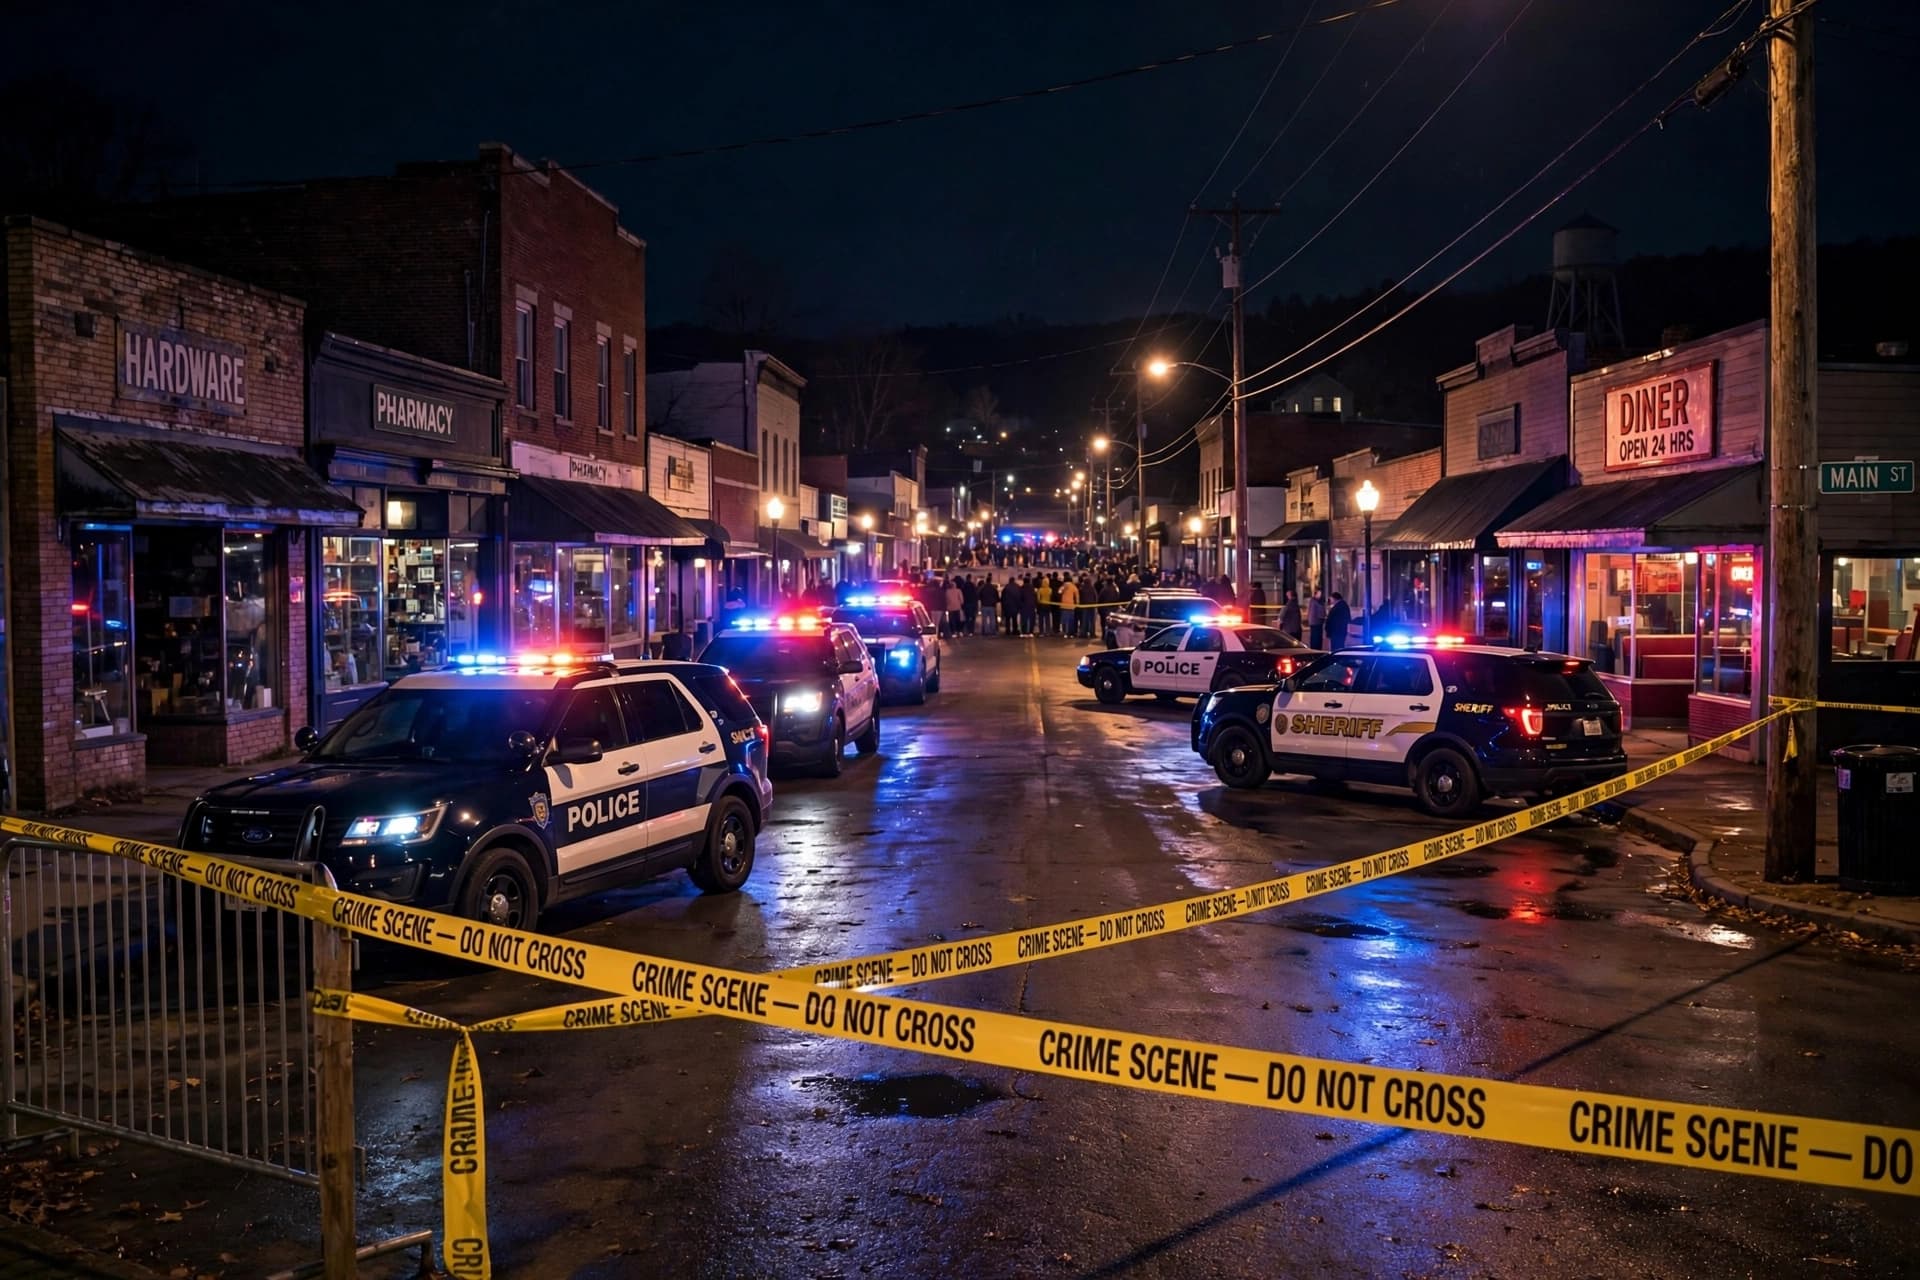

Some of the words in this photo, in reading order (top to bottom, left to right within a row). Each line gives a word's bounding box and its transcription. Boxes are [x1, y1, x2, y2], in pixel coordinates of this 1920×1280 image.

[125, 332, 245, 405] HARDWARE
[377, 391, 453, 435] PHARMACY
[1620, 379, 1689, 436] DINER
[1620, 437, 1648, 462] OPEN
[1651, 434, 1666, 457] 24
[1670, 429, 1694, 454] HRS
[1831, 466, 1878, 489] MAIN
[1890, 466, 1907, 482] ST
[1144, 660, 1200, 676] POLICE
[1290, 713, 1383, 739] SHERIFF
[567, 789, 640, 833] POLICE
[113, 840, 149, 864] CRIME
[148, 848, 188, 877] SCENE
[205, 862, 224, 887] DO
[226, 868, 254, 896] NOT
[253, 876, 300, 909] CROSS
[1306, 872, 1327, 893] CRIME
[1328, 865, 1351, 888] SCENE
[1362, 860, 1373, 879] DO
[1373, 856, 1386, 875] NOT
[1388, 849, 1409, 871] CROSS
[1186, 899, 1211, 923] CRIME
[1213, 893, 1237, 917] SCENE
[1266, 881, 1290, 904] CROSS
[332, 896, 381, 932] CRIME
[382, 908, 435, 945] SCENE
[460, 926, 484, 957] DO
[488, 931, 524, 965] NOT
[526, 940, 587, 979] CROSS
[1018, 931, 1050, 958] CRIME
[1052, 925, 1084, 952] SCENE
[1100, 919, 1113, 942] DO
[1115, 915, 1133, 939] NOT
[1136, 909, 1165, 933] CROSS
[814, 965, 853, 989] CRIME
[856, 958, 894, 988] SCENE
[912, 951, 928, 977] DO
[931, 948, 953, 975] NOT
[956, 942, 992, 970] CROSS
[563, 1004, 616, 1028] CRIME
[619, 1000, 671, 1023] SCENE
[632, 961, 696, 1003] CRIME
[700, 973, 769, 1016] SCENE
[805, 991, 836, 1028] DO
[843, 998, 890, 1038] NOT
[895, 1008, 976, 1053] CROSS
[1039, 1028, 1121, 1077] CRIME
[1129, 1042, 1218, 1091] SCENE
[1267, 1061, 1306, 1104] DO
[1316, 1068, 1375, 1115] NOT
[1384, 1076, 1486, 1130] CROSS
[1569, 1100, 1675, 1154] CRIME
[1685, 1114, 1799, 1171] SCENE
[1863, 1134, 1913, 1185] DO
